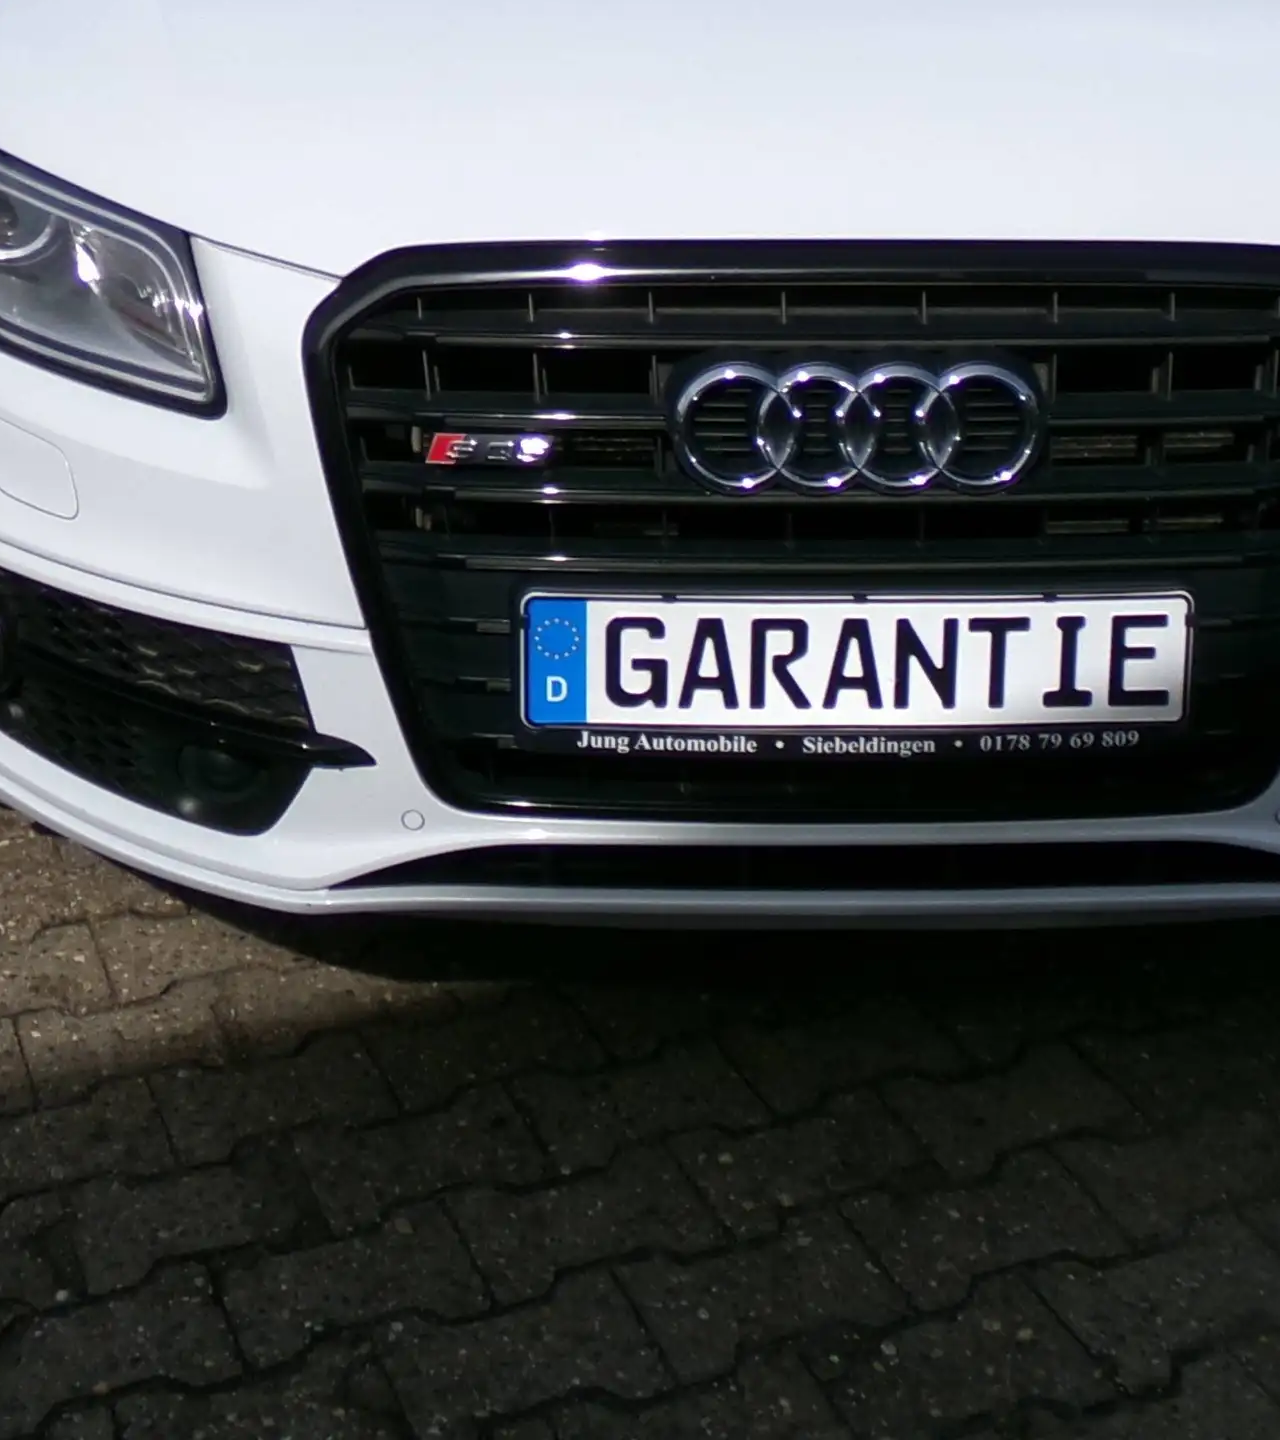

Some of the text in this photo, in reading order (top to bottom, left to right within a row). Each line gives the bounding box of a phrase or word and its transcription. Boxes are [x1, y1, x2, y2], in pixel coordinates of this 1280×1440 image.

[545, 615, 1170, 709] D GARANTIE
[576, 729, 1140, 758] Jung Automobile Siebeldingen 0178 79 69 809
